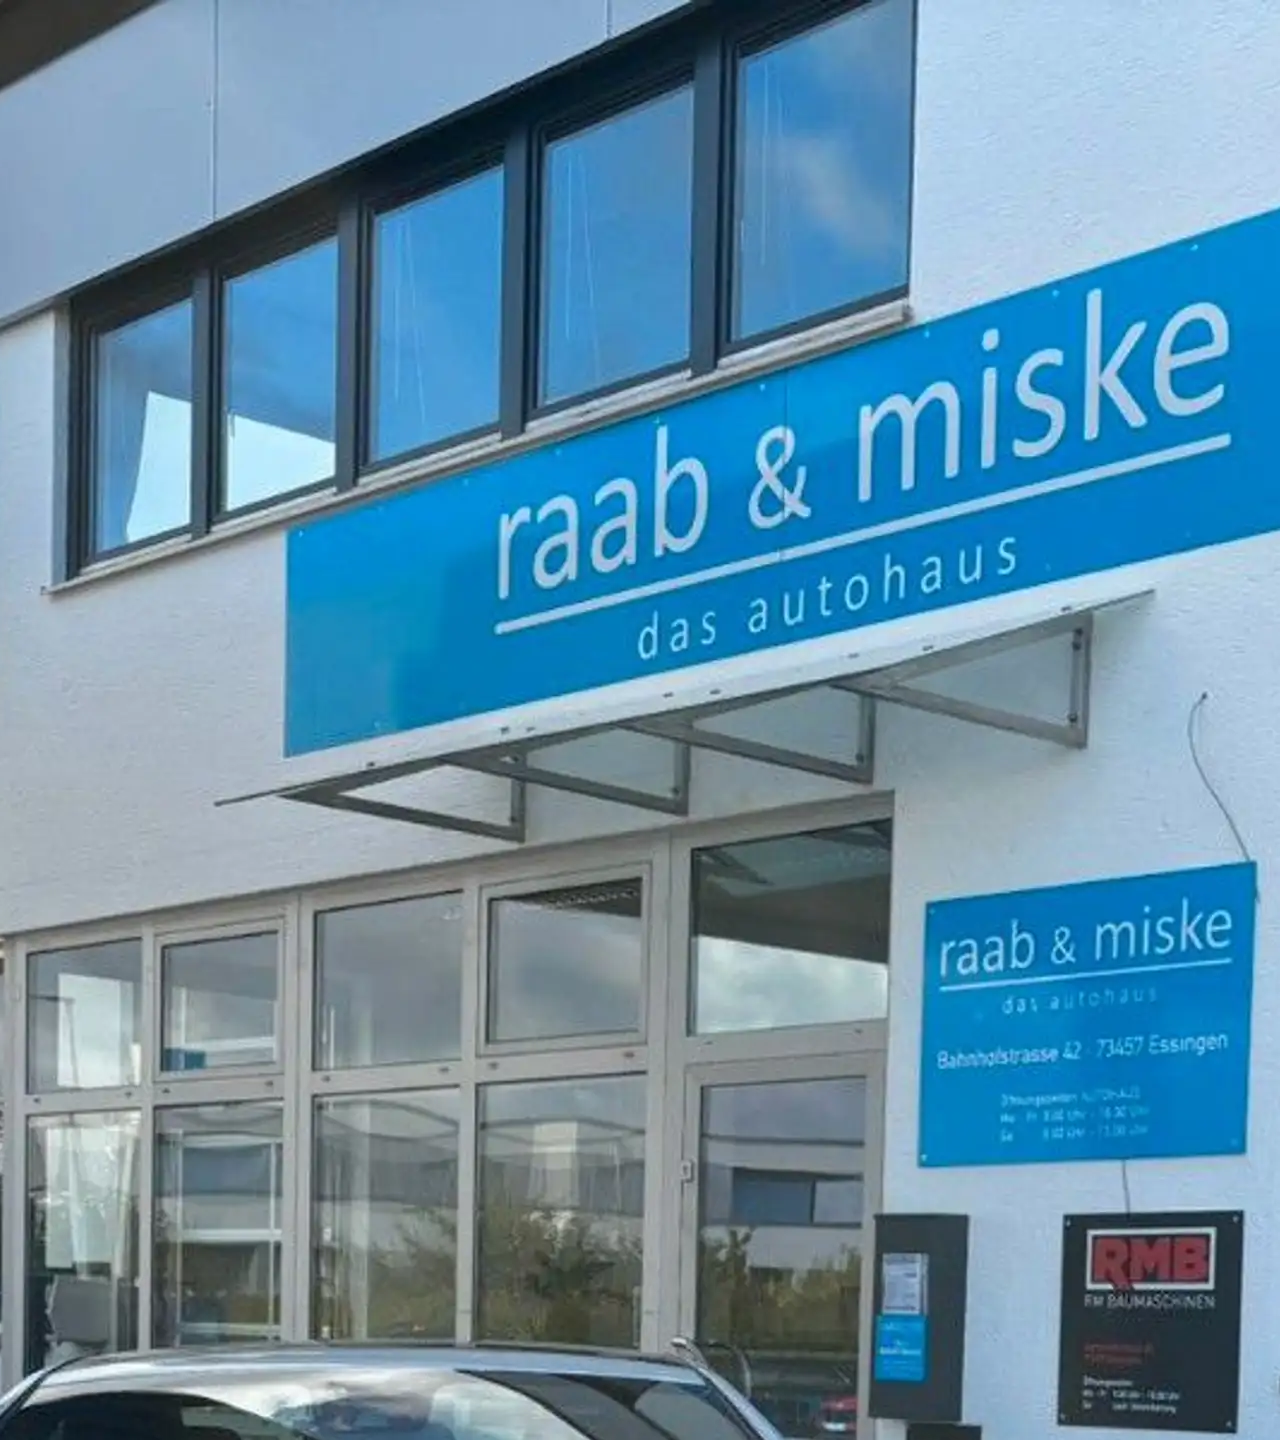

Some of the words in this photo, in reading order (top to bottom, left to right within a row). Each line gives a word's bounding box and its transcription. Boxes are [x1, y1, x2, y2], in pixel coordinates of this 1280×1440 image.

[497, 426, 709, 600] raab
[748, 424, 811, 531] &
[858, 289, 1231, 503] miske
[637, 600, 717, 661] das
[747, 535, 1019, 636] autohaus
[939, 918, 1035, 977] raab
[1050, 926, 1076, 963] &
[1095, 897, 1232, 961] miske
[1062, 1041, 1082, 1061] 42
[1148, 1032, 1228, 1056] Essingen
[1093, 1236, 1208, 1291] RMB
